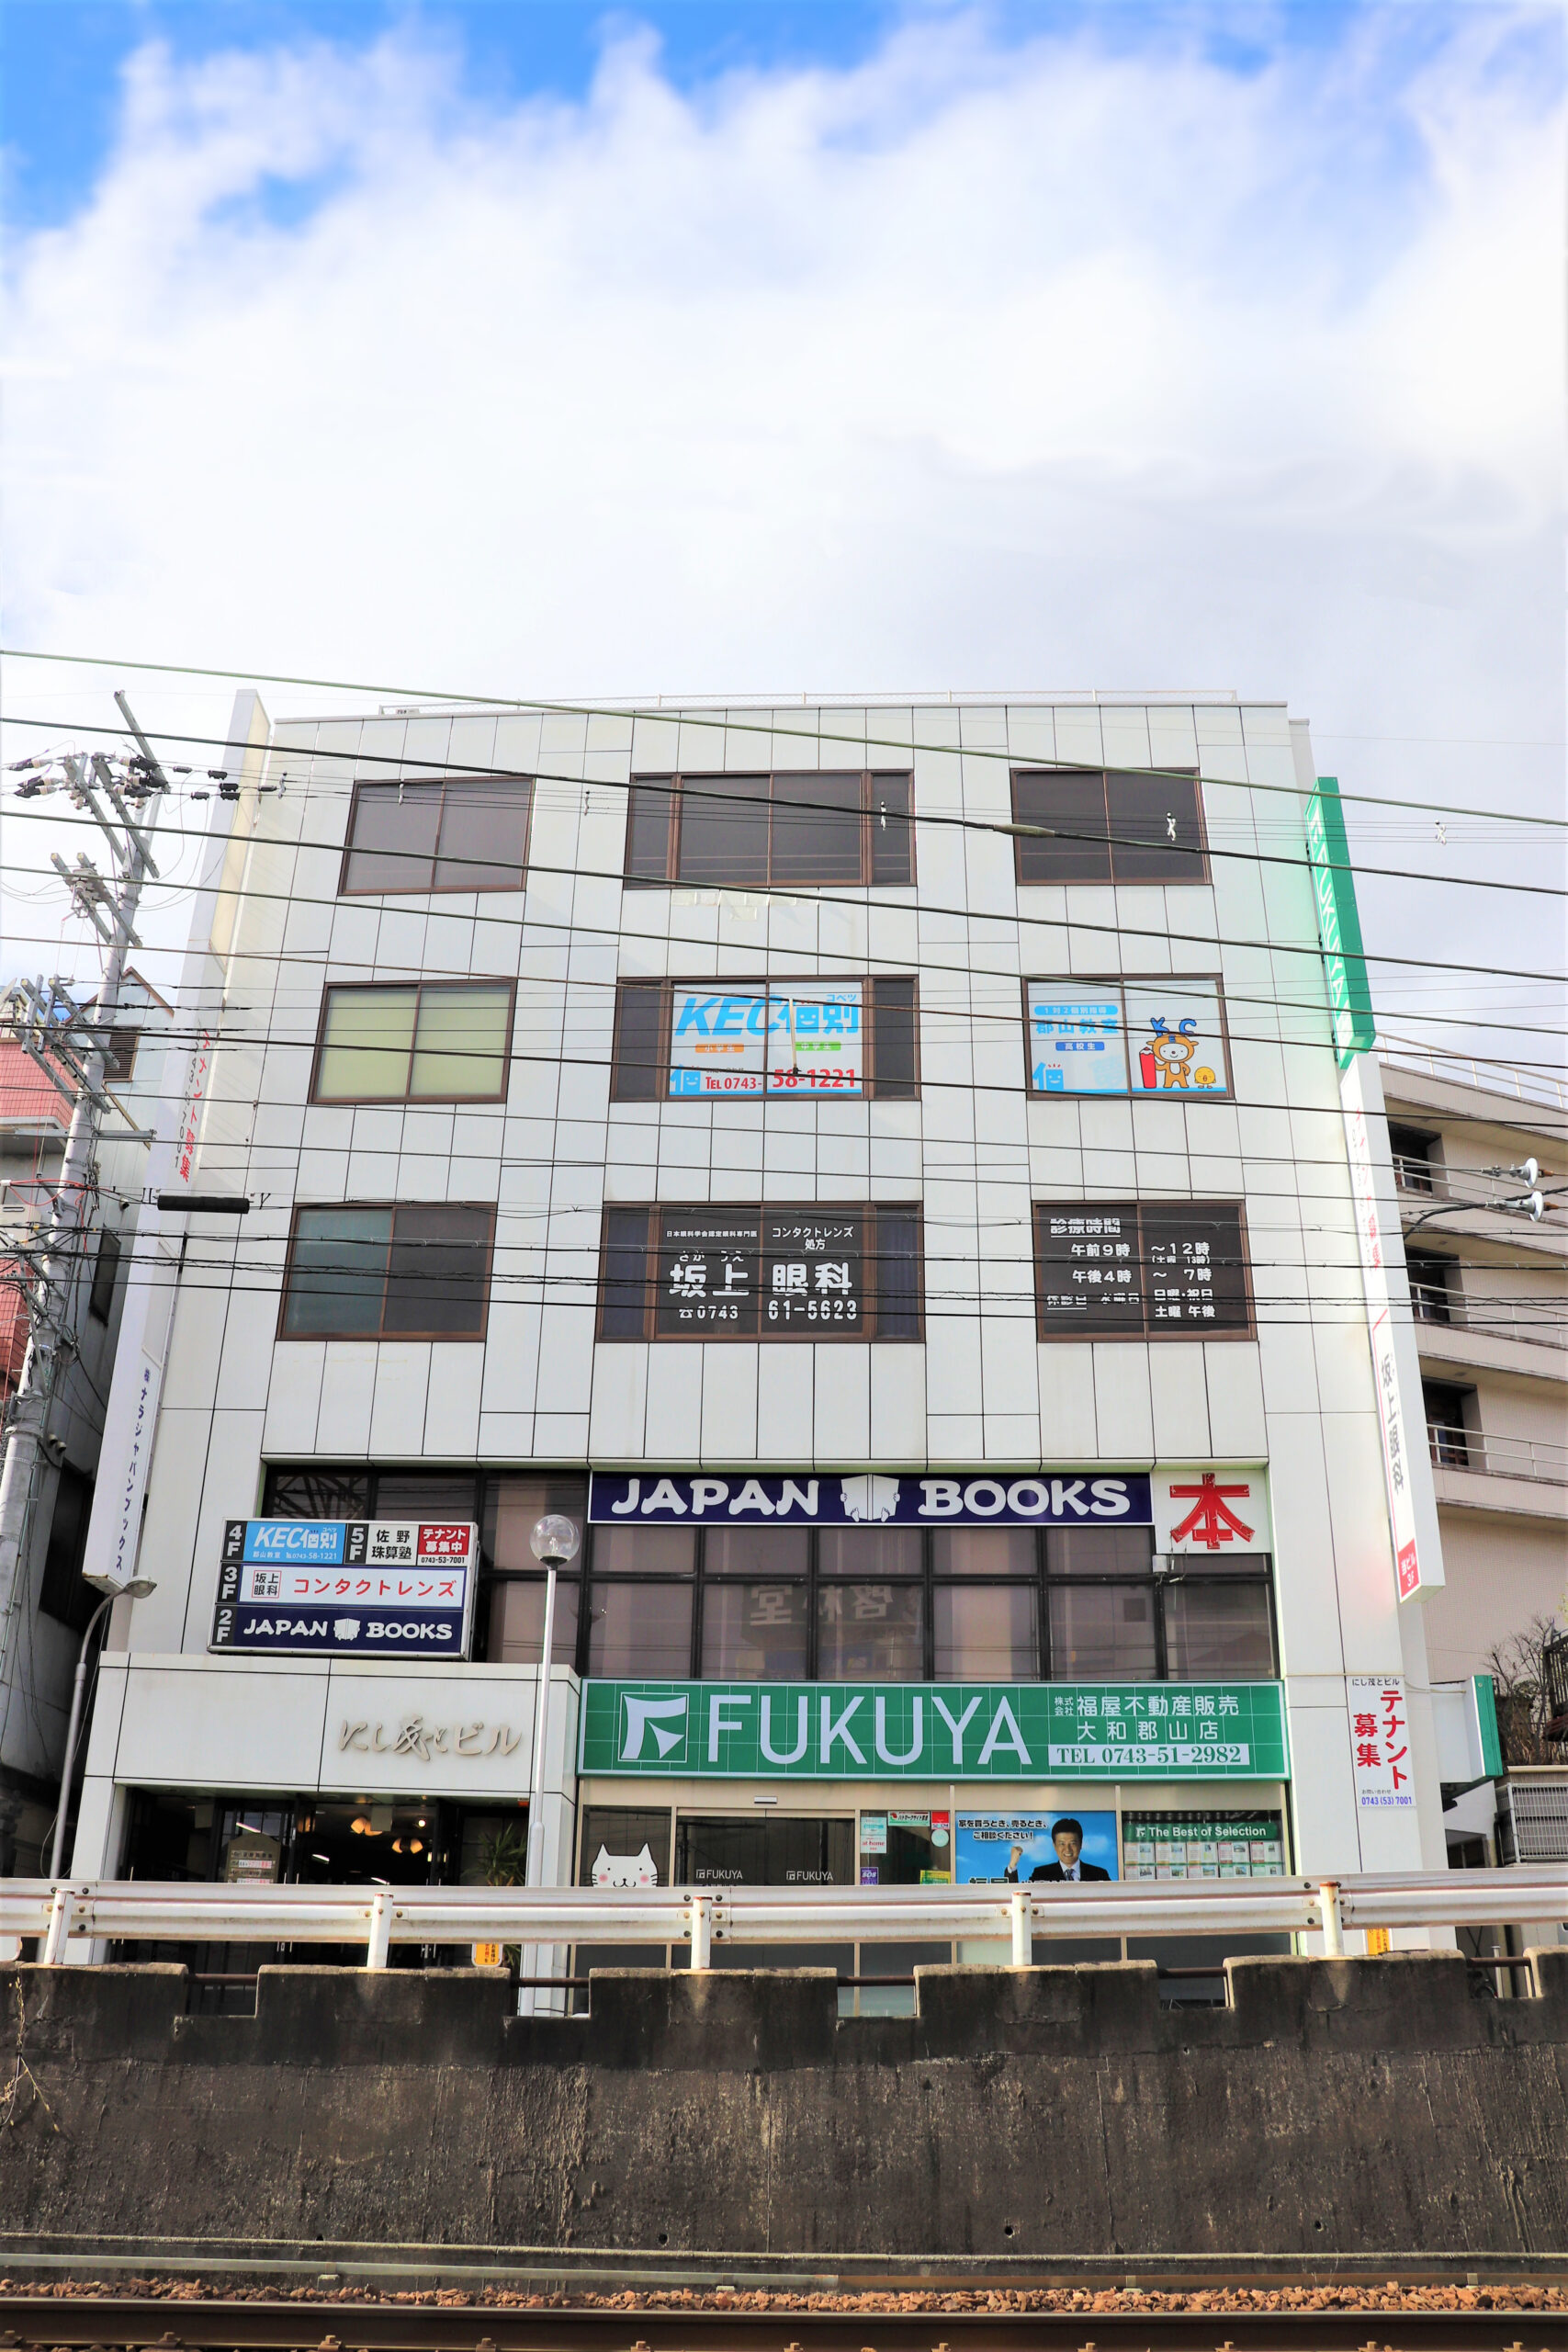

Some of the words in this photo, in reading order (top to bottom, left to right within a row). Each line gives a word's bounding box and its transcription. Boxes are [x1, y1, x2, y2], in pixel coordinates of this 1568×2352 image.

[1036, 1019, 1119, 1035] 郡山教室
[772, 1227, 853, 1238] コンタクトレンズ
[1050, 1217, 1121, 1234] 診療時間
[805, 1238, 826, 1250] 処方
[669, 1263, 750, 1298] 坂上
[772, 1262, 852, 1296] 眼科
[768, 1300, 858, 1320] 61-5623
[611, 1478, 819, 1516] JAPAN
[918, 1479, 1131, 1517] BOOKS
[1169, 1472, 1256, 1550] 本
[423, 1529, 466, 1541] テナント
[371, 1545, 412, 1561] 珠算塾
[425, 1541, 462, 1554] 募集中
[421, 1556, 465, 1565] 0743-53-7001
[254, 1572, 279, 1584] 坂上
[254, 1585, 278, 1597] 眼科
[293, 1578, 457, 1598] コンタクトレンズ
[243, 1619, 328, 1636] JAPAN
[366, 1623, 453, 1641] BOOKS
[1077, 1695, 1239, 1716] 福屋不動産販売
[707, 1694, 1033, 1765] FUKUYA
[1077, 1721, 1219, 1741] 大和郡山店
[1352, 1713, 1382, 1769] 募集
[1380, 1690, 1408, 1791] テナント
[1057, 1747, 1096, 1764] TEL
[1101, 1747, 1241, 1764] 0743-51-2982
[1149, 1826, 1169, 1837] The
[1172, 1826, 1198, 1837] Best
[1201, 1826, 1213, 1836] of
[1214, 1826, 1266, 1837] Selection
[706, 1869, 743, 1880] FUKUYA
[796, 1871, 833, 1882] FUKUYA
